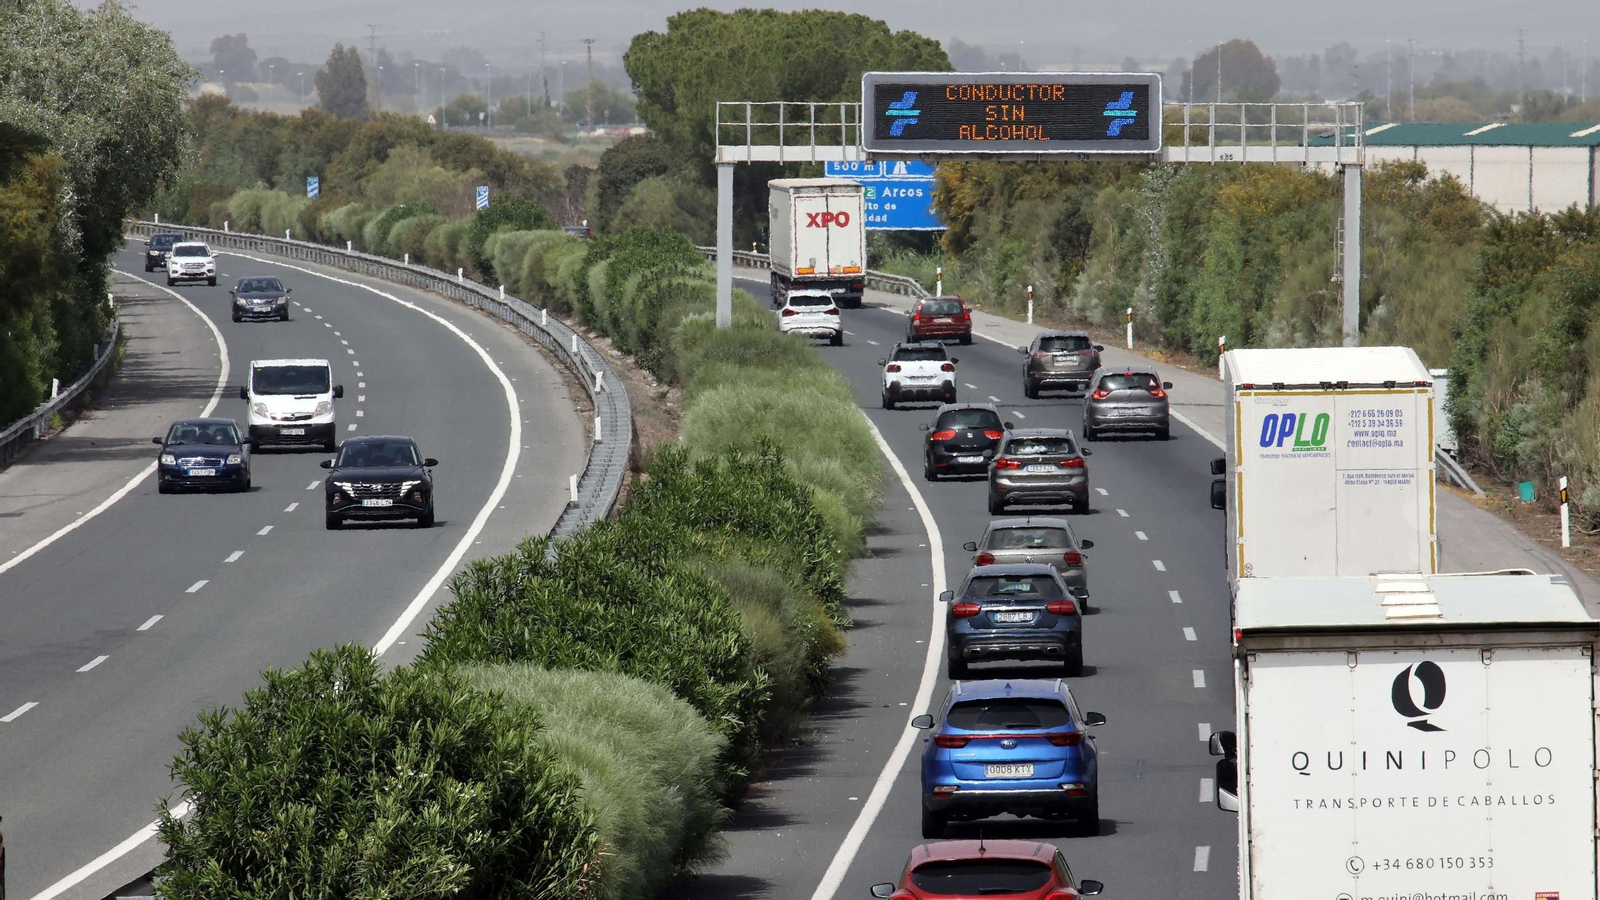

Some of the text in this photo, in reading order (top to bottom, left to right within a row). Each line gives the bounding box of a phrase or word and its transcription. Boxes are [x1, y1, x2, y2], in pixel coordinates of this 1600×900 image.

[946, 84, 1065, 101] CONDUCTOR
[985, 104, 1025, 121] SIN
[959, 124, 1050, 141] ALCOHOL
[833, 161, 858, 171] 500
[882, 186, 924, 198] Arcos
[883, 202, 897, 211] de
[806, 211, 850, 228] XPO
[1260, 412, 1331, 448] OPLO
[1346, 439, 1404, 448] contact@oplo.ma
[1291, 747, 1553, 775] QUINIPOLO
[989, 765, 1031, 774] 0008 KTX
[1293, 794, 1556, 810] TRANSPORTE DE CABALLOS
[1372, 856, 1495, 872] +34 680 150 353
